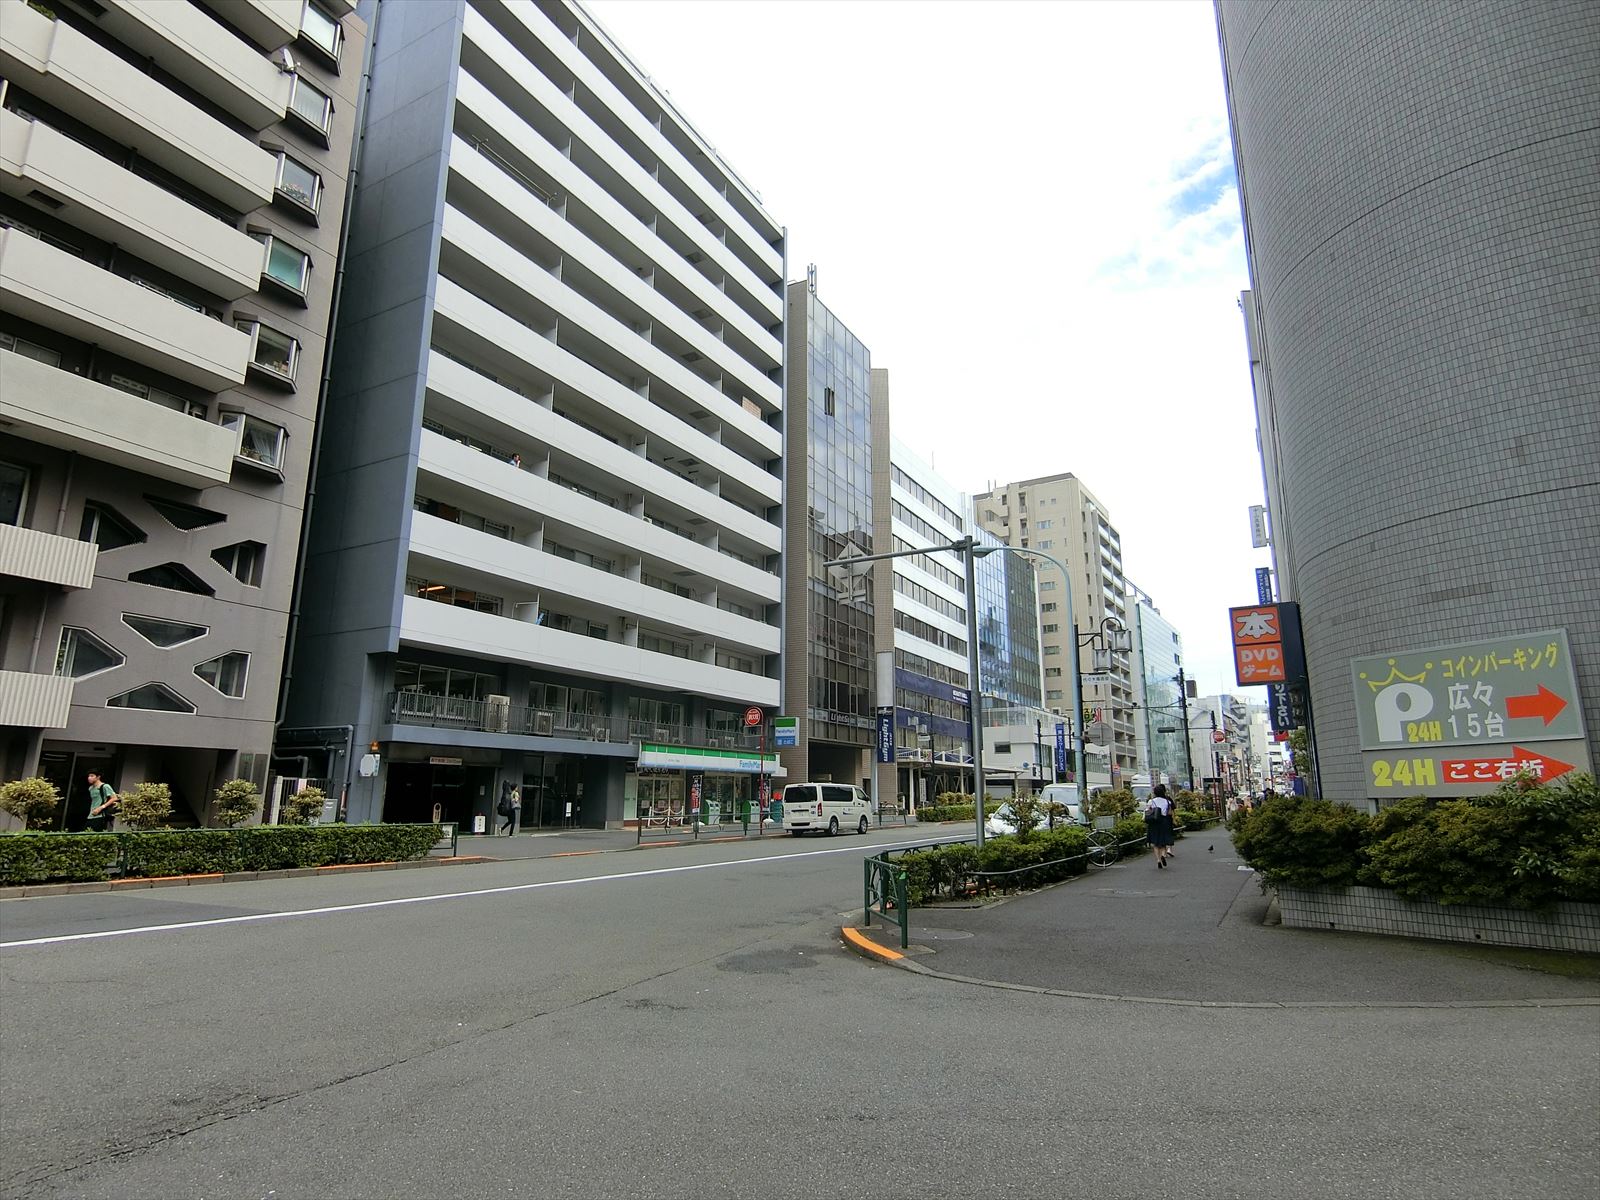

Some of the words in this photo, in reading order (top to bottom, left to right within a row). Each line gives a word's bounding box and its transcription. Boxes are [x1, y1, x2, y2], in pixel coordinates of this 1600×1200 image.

[1236, 611, 1277, 638] 本
[1241, 647, 1279, 663] DVD
[1441, 642, 1558, 679] コインパーキング
[1242, 664, 1281, 677] ゲーム
[1447, 681, 1494, 712] 広々
[1406, 721, 1443, 743] 24H
[1447, 711, 1504, 738] 15台
[1372, 758, 1437, 787] 24H
[1450, 759, 1544, 779] ここ右折
